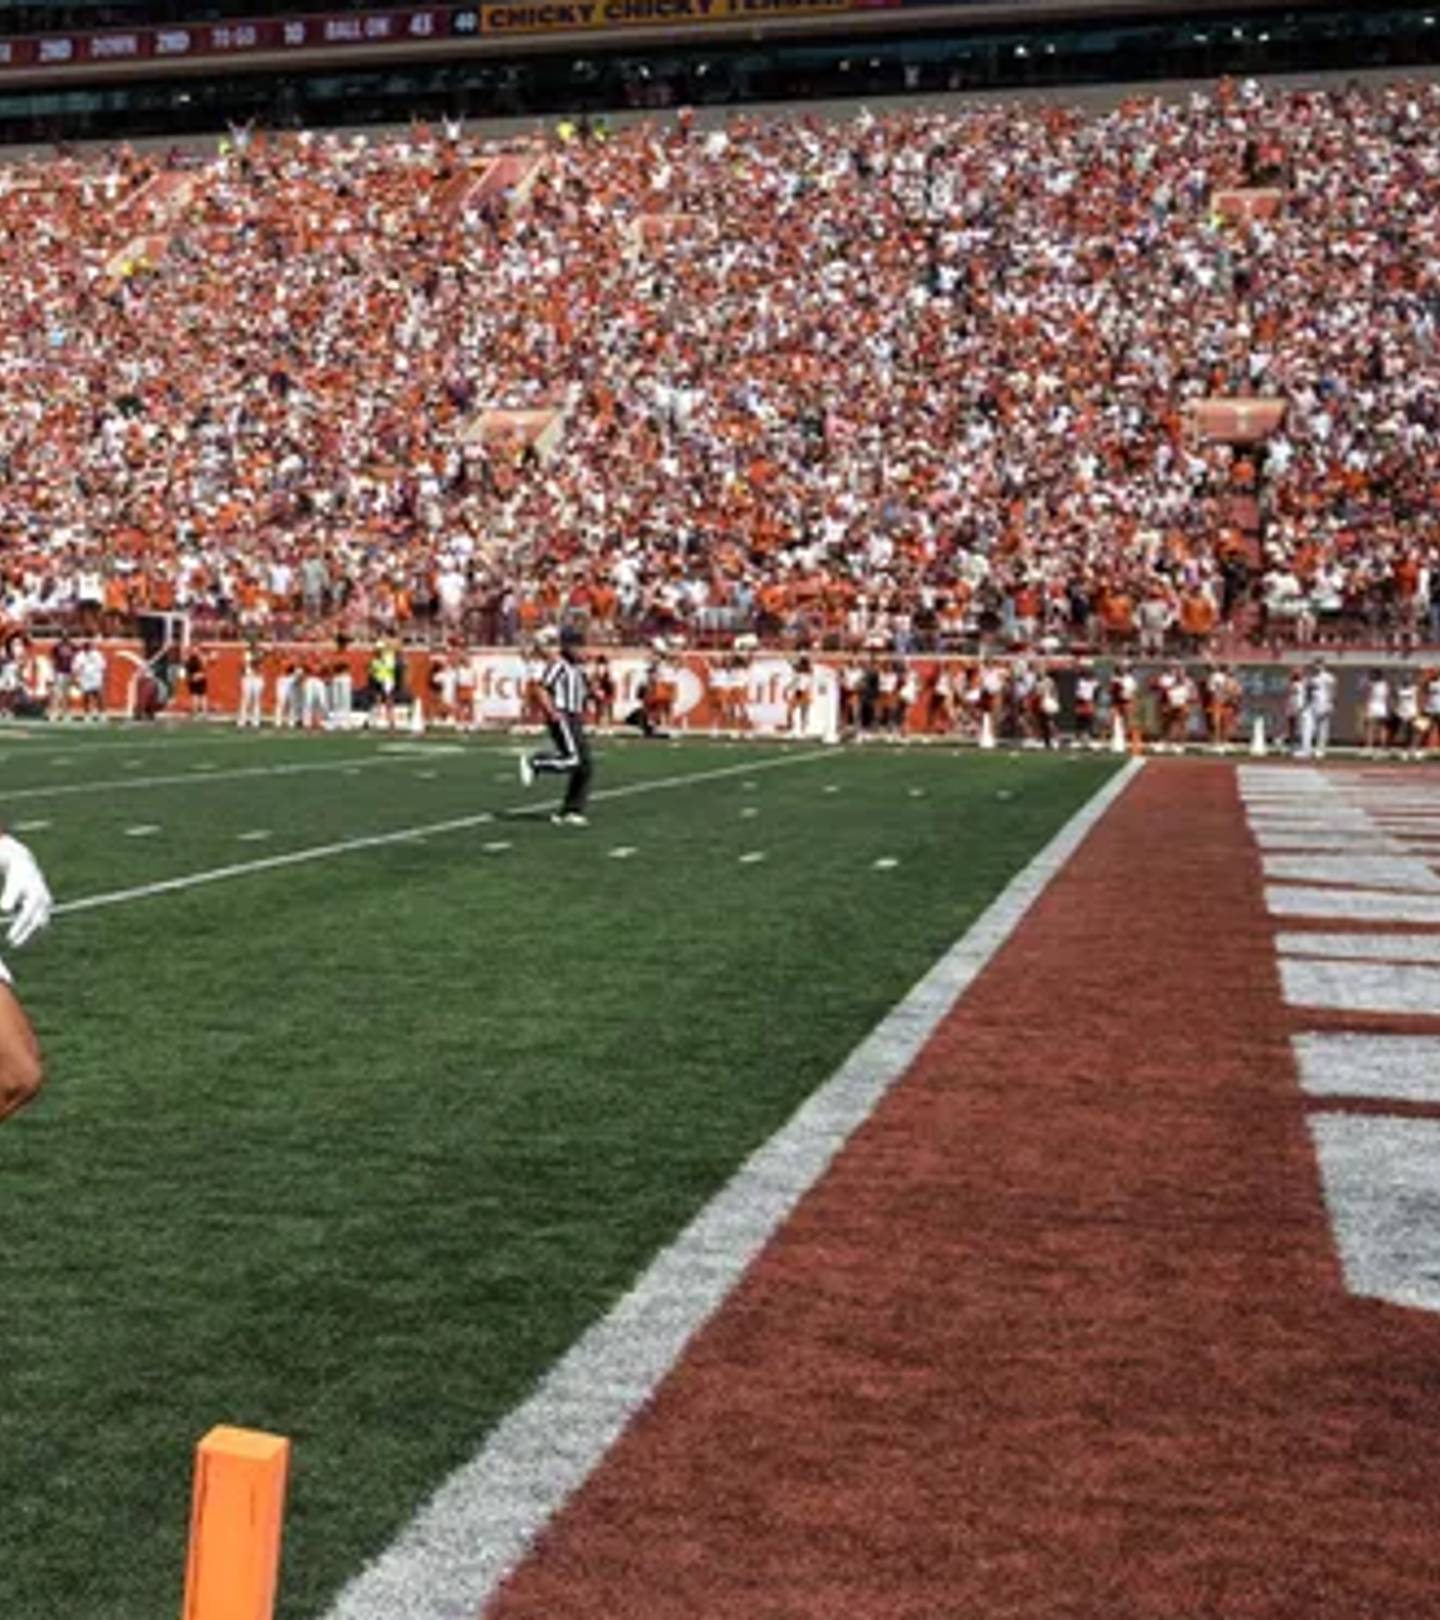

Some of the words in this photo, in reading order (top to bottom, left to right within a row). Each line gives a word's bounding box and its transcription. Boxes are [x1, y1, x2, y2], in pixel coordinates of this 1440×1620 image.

[488, 3, 596, 28] CHICKY
[39, 38, 73, 61] 2ND
[91, 34, 137, 56] DOWN
[155, 29, 191, 53] 2ND
[324, 19, 360, 41] BALL
